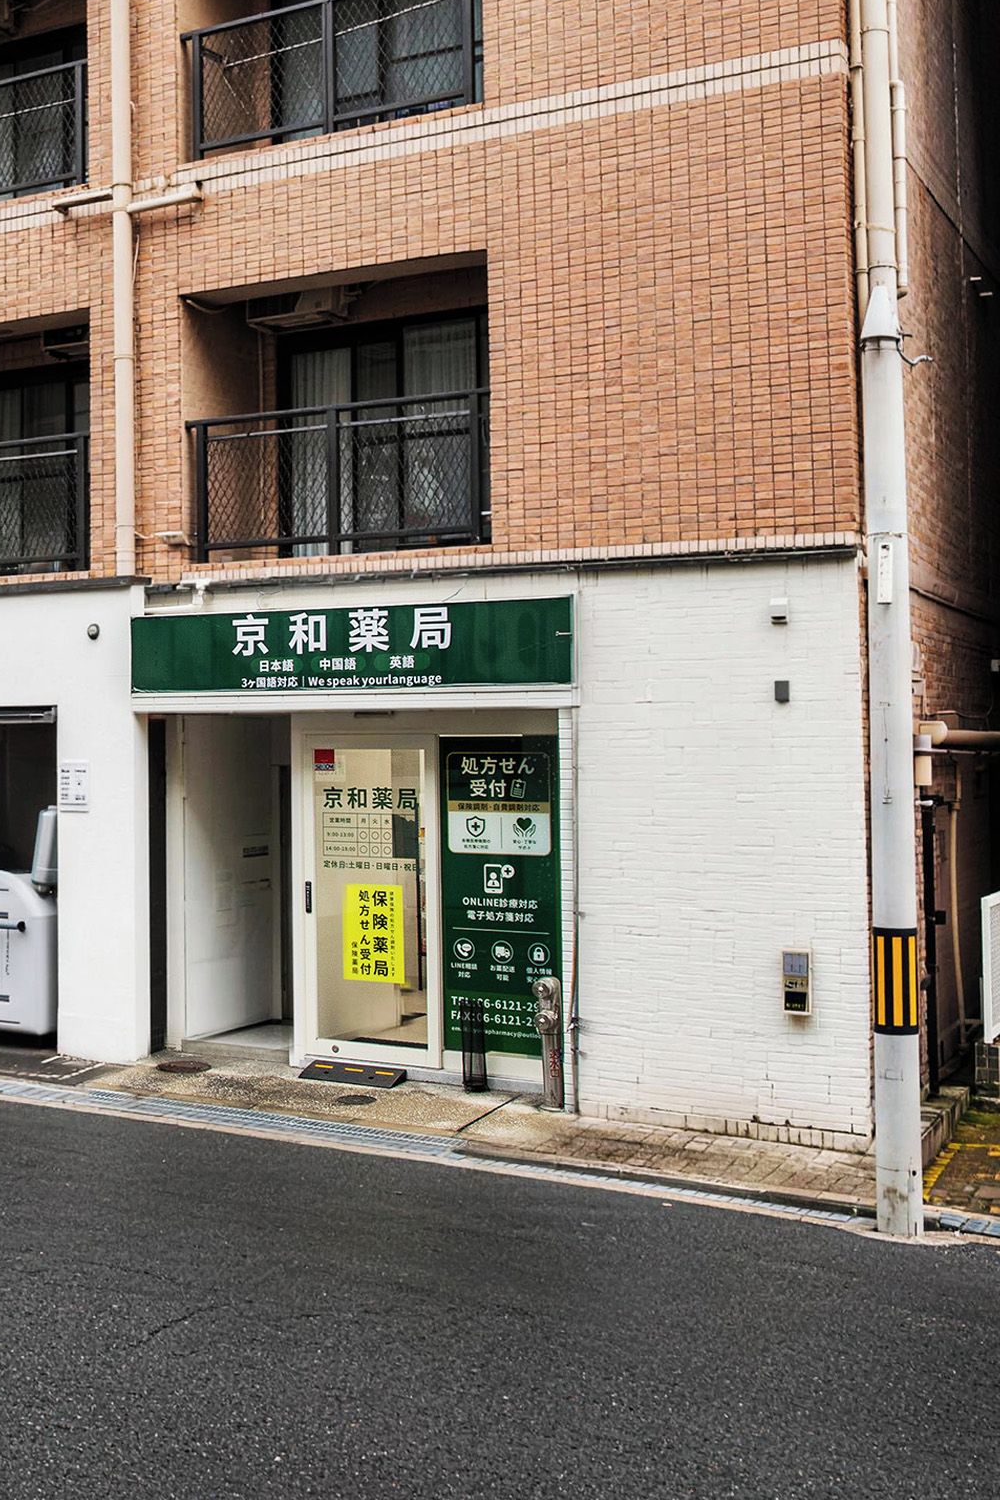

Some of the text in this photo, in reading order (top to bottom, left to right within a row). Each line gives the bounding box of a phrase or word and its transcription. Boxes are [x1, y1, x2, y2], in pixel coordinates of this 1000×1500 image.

[232, 606, 452, 656] 京和薬局
[259, 655, 415, 673] 日本語 中国語 英語
[308, 676, 325, 687] We
[326, 675, 360, 687] speak
[461, 756, 535, 775] 処方せん
[323, 786, 418, 809] 京和薬局
[470, 779, 507, 797] 受付
[462, 896, 538, 909] ONLINE診療対応
[359, 889, 371, 976] 処方せん受付
[372, 890, 389, 977] 保険薬局
